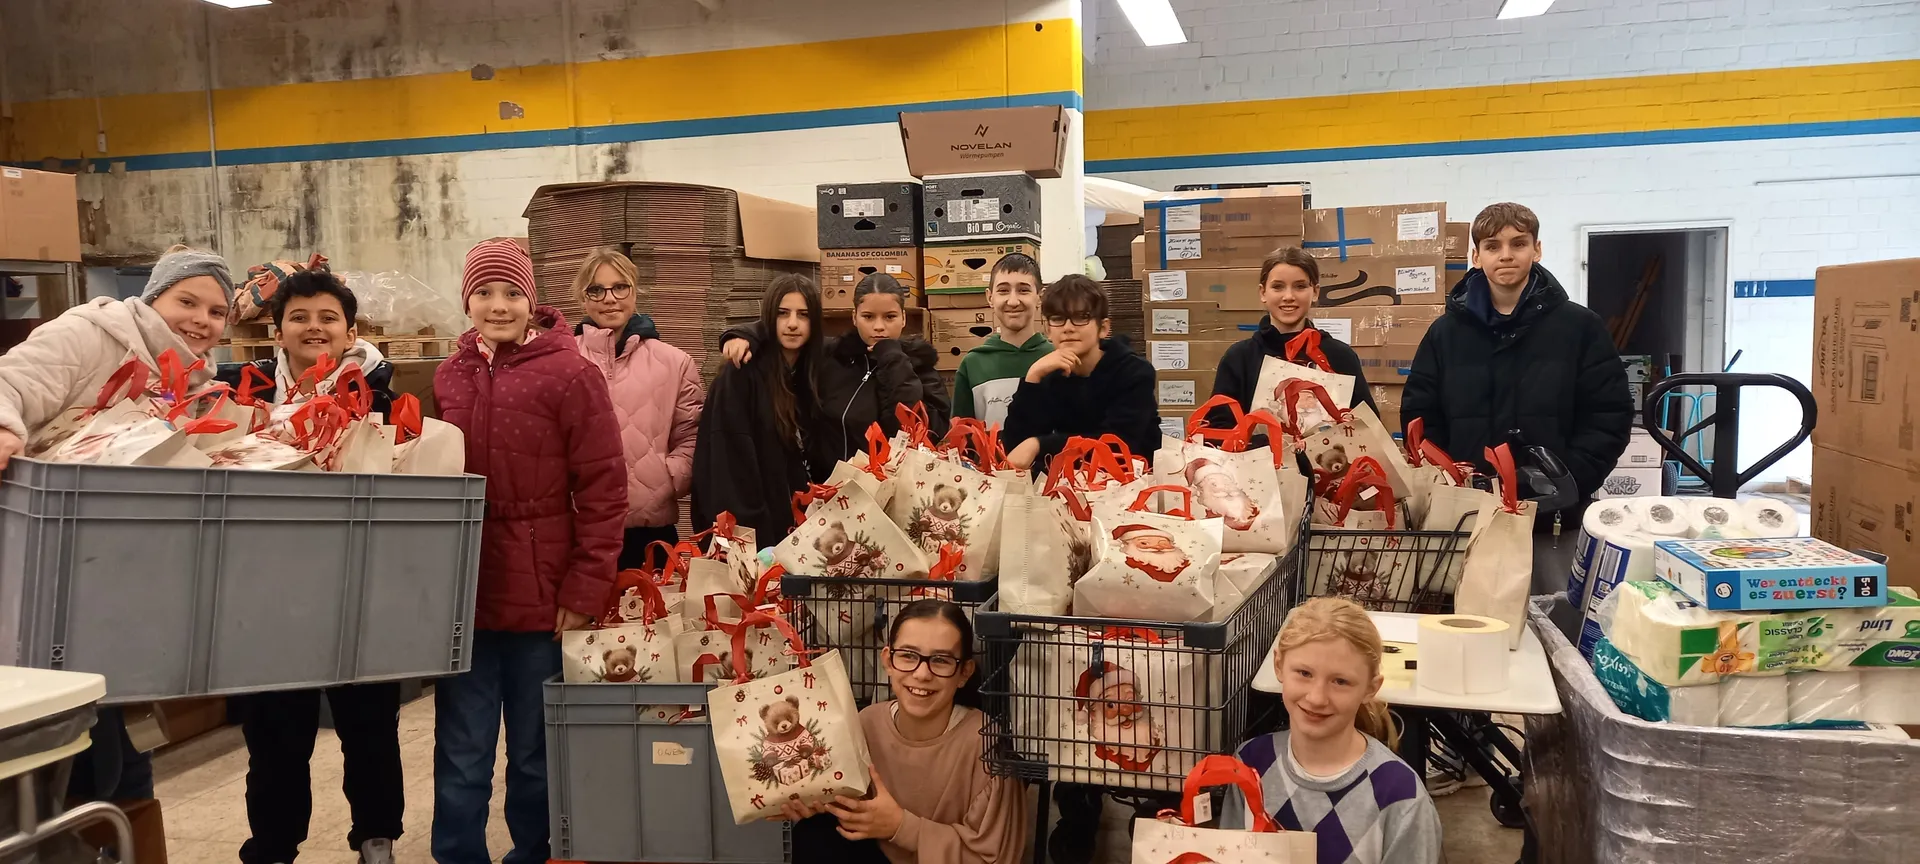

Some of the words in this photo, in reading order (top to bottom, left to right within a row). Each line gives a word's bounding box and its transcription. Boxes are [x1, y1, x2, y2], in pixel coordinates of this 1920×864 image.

[950, 142, 1012, 151] NOVELAN
[1605, 475, 1637, 486] SUPER
[1602, 484, 1642, 496] WINGS
[1747, 578, 1776, 588] Wer
[1779, 576, 1848, 588] entdeckt
[1861, 577, 1871, 596] 5-10
[1749, 590, 1768, 600] es
[1772, 586, 1848, 600] zuerst?
[1764, 627, 1803, 636] CLASSIC
[1807, 616, 1825, 638] 2
[1859, 619, 1894, 632] Lind
[1887, 649, 1919, 660] Zewa
